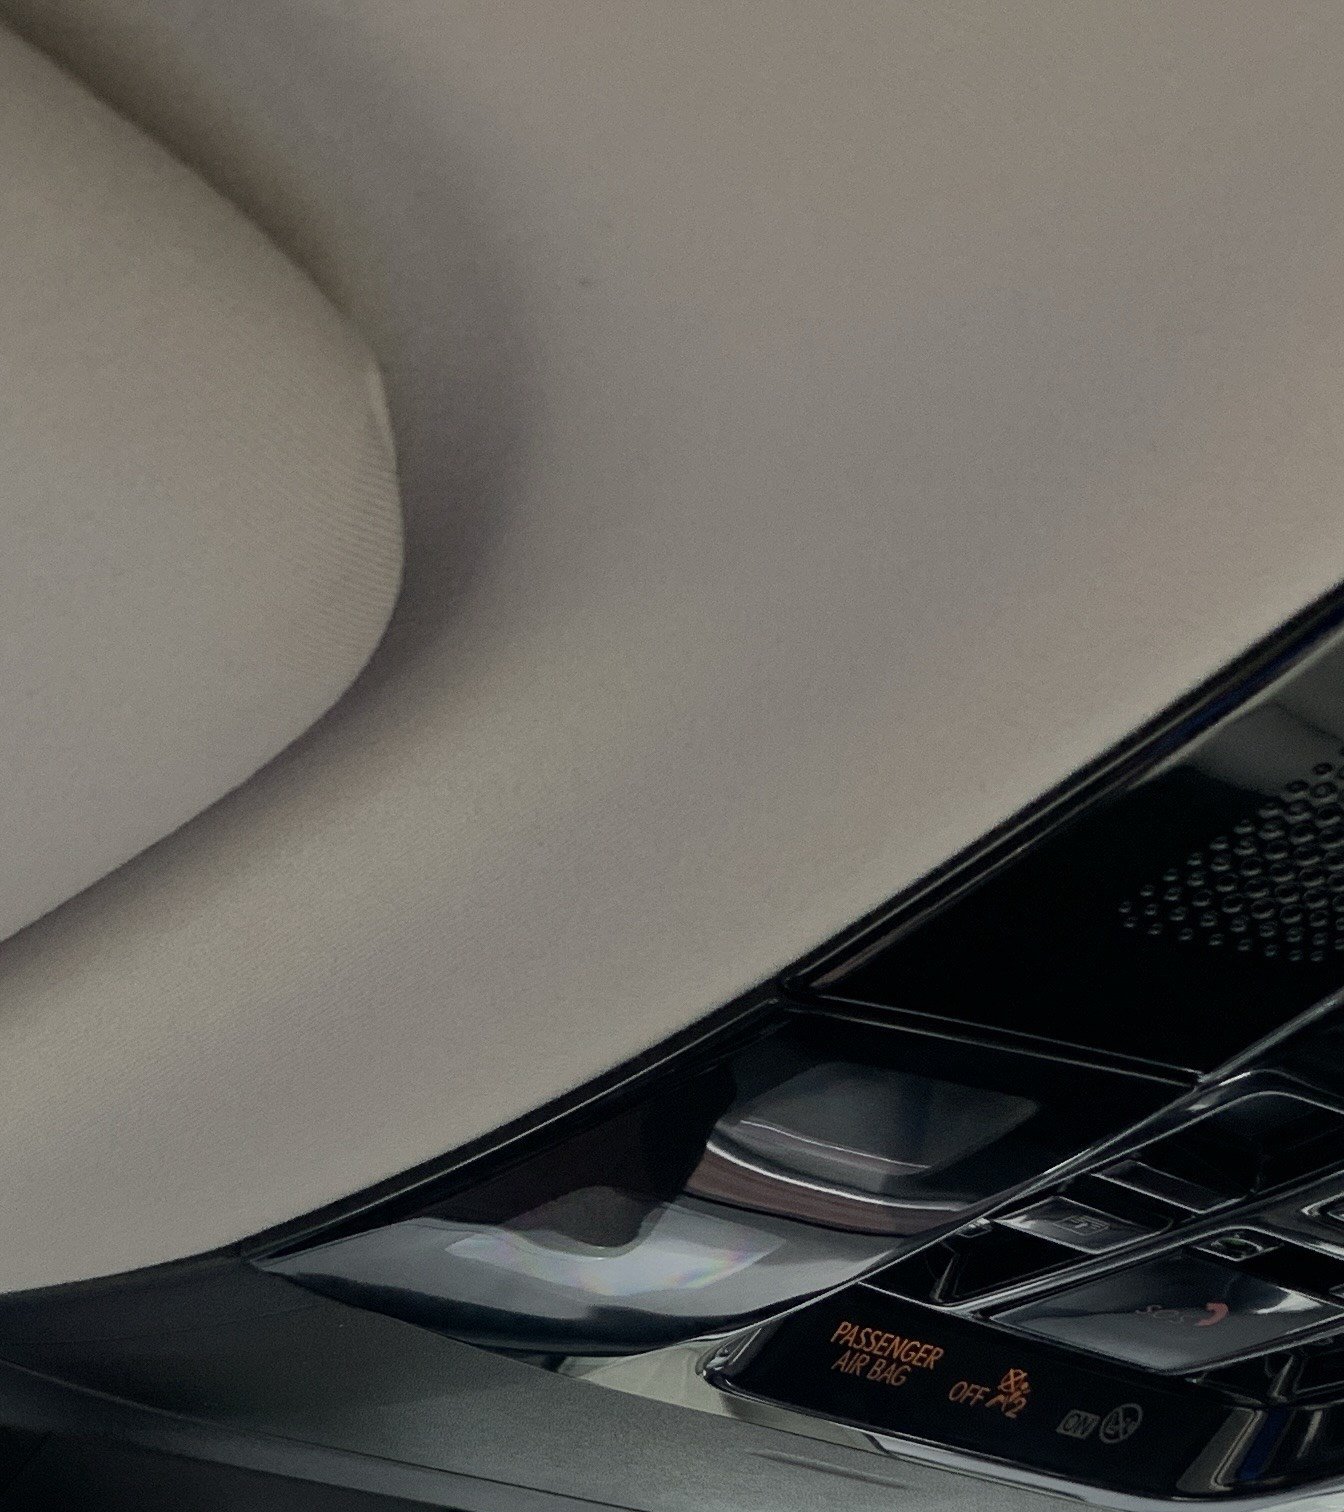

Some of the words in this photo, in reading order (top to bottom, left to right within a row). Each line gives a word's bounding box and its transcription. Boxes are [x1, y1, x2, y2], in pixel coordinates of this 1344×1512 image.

[830, 1321, 945, 1370] PASSENGER
[830, 1349, 870, 1377] AIR
[867, 1358, 912, 1387] BAG
[949, 1380, 991, 1407] OFF
[1061, 1412, 1096, 1436] ON
